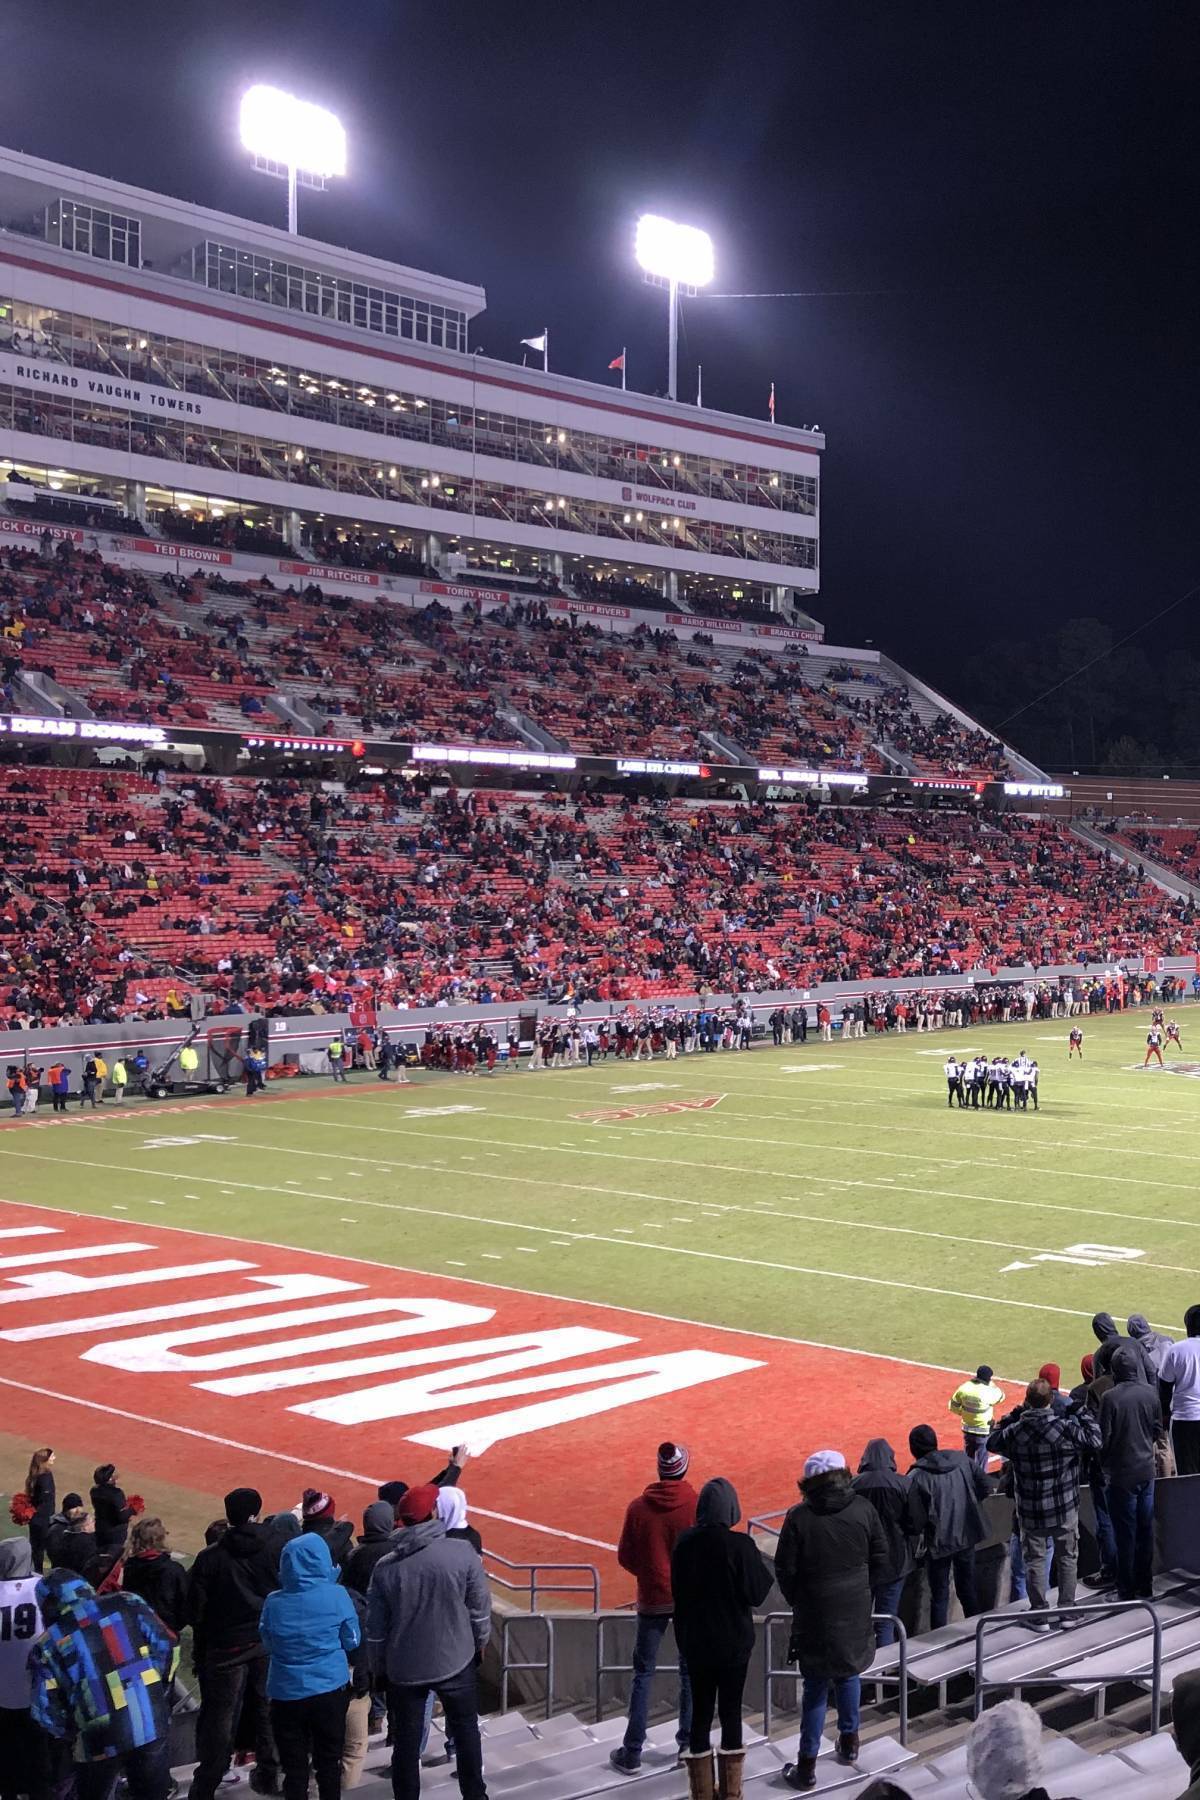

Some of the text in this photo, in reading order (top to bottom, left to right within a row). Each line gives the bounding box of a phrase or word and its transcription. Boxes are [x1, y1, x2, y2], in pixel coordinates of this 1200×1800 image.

[16, 365, 202, 414] RICHARD VAUGHN TOWERS
[636, 491, 675, 508] WOLFPACK
[677, 500, 696, 510] CLUB
[0, 520, 19, 532] CK
[154, 543, 220, 562] TED BROWN
[306, 566, 371, 584] JIM RITCHER
[446, 586, 502, 601] TORRY HOLT
[567, 602, 627, 617] PHILIP RIVERS
[681, 617, 741, 631] MARIO WILLIAMS
[770, 628, 823, 641] BRADLEY CHUBB
[1029, 1243, 1147, 1267] 10
[0, 1602, 37, 1641] 19
